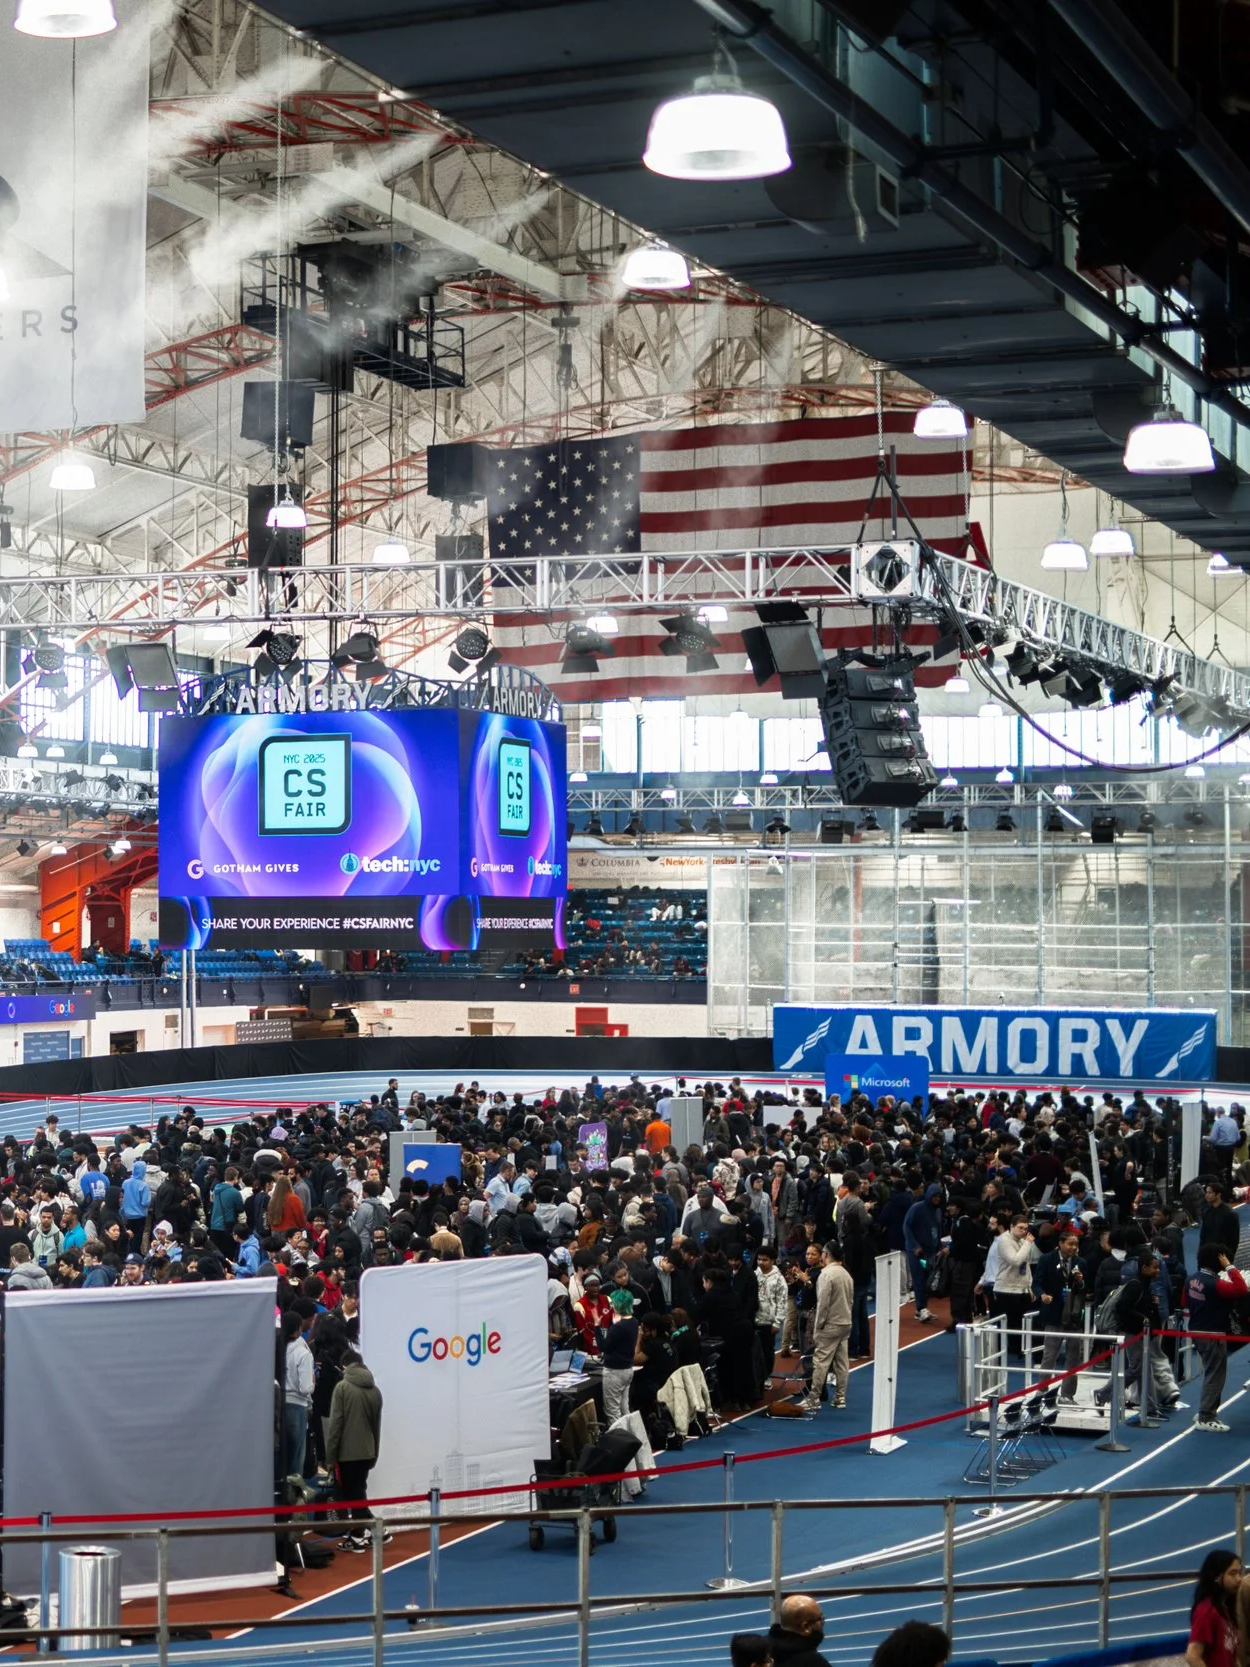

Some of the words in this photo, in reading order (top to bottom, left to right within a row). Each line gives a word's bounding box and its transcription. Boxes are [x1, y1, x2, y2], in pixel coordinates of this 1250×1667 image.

[236, 683, 372, 714] ARMORY
[493, 686, 542, 719] ARMORY
[283, 754, 301, 765] NYC
[303, 753, 327, 764] 2025
[283, 768, 327, 798] CS
[507, 771, 523, 801] CS
[284, 802, 327, 818] FAIR
[507, 803, 523, 819] FAIR
[214, 863, 261, 874] GOTHAM
[265, 863, 299, 873] GIVES
[360, 855, 441, 877] tech:nyc
[201, 918, 236, 929] SHARE
[239, 918, 271, 929] YOUR
[273, 918, 340, 929] EXPERIENCE
[342, 917, 414, 930] #CSFAIRNYC
[49, 999, 75, 1017] Google
[845, 1014, 1150, 1077] ARMORY
[861, 1076, 910, 1088] Microsoft
[408, 1321, 502, 1367] Google
